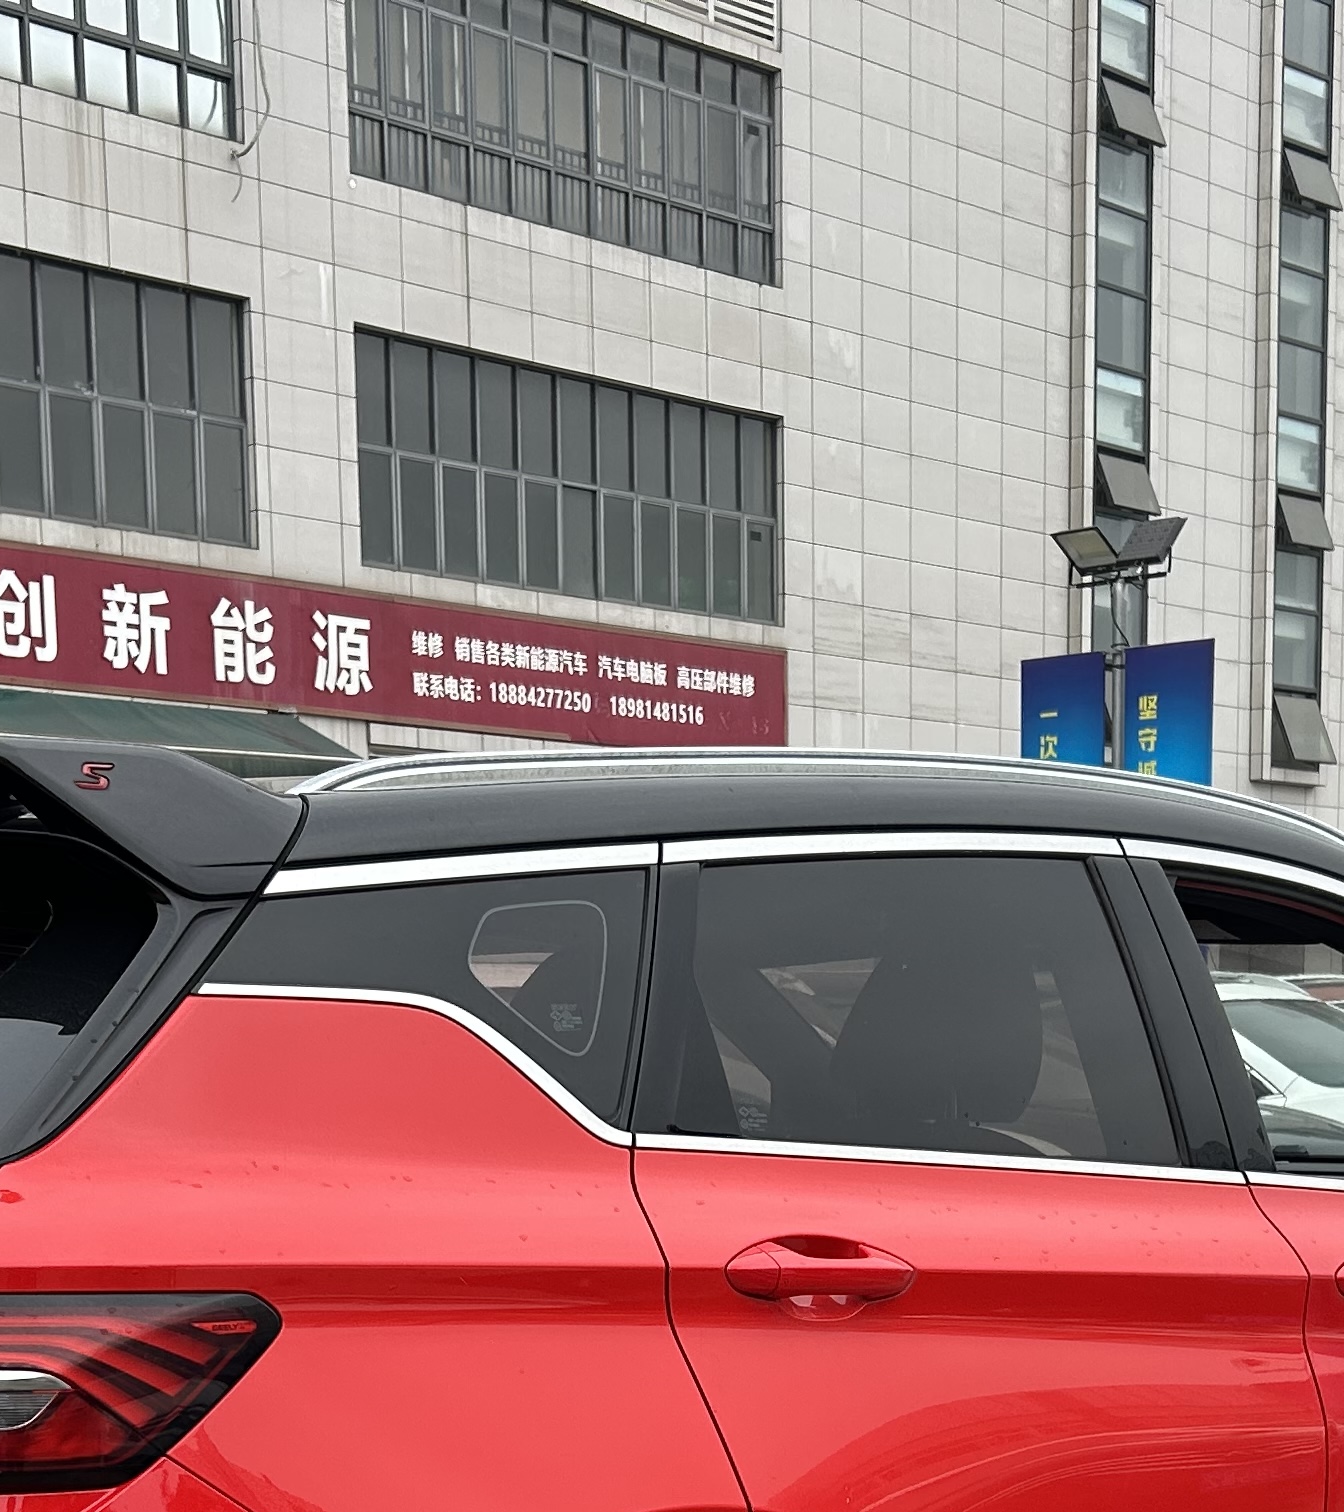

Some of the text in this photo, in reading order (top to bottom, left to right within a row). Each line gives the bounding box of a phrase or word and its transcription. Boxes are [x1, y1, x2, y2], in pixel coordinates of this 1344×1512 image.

[411, 630, 756, 699] 维修 销售各类新能源汽车 汽车电脑板 高压部件维修
[609, 696, 704, 726] 18981481516
